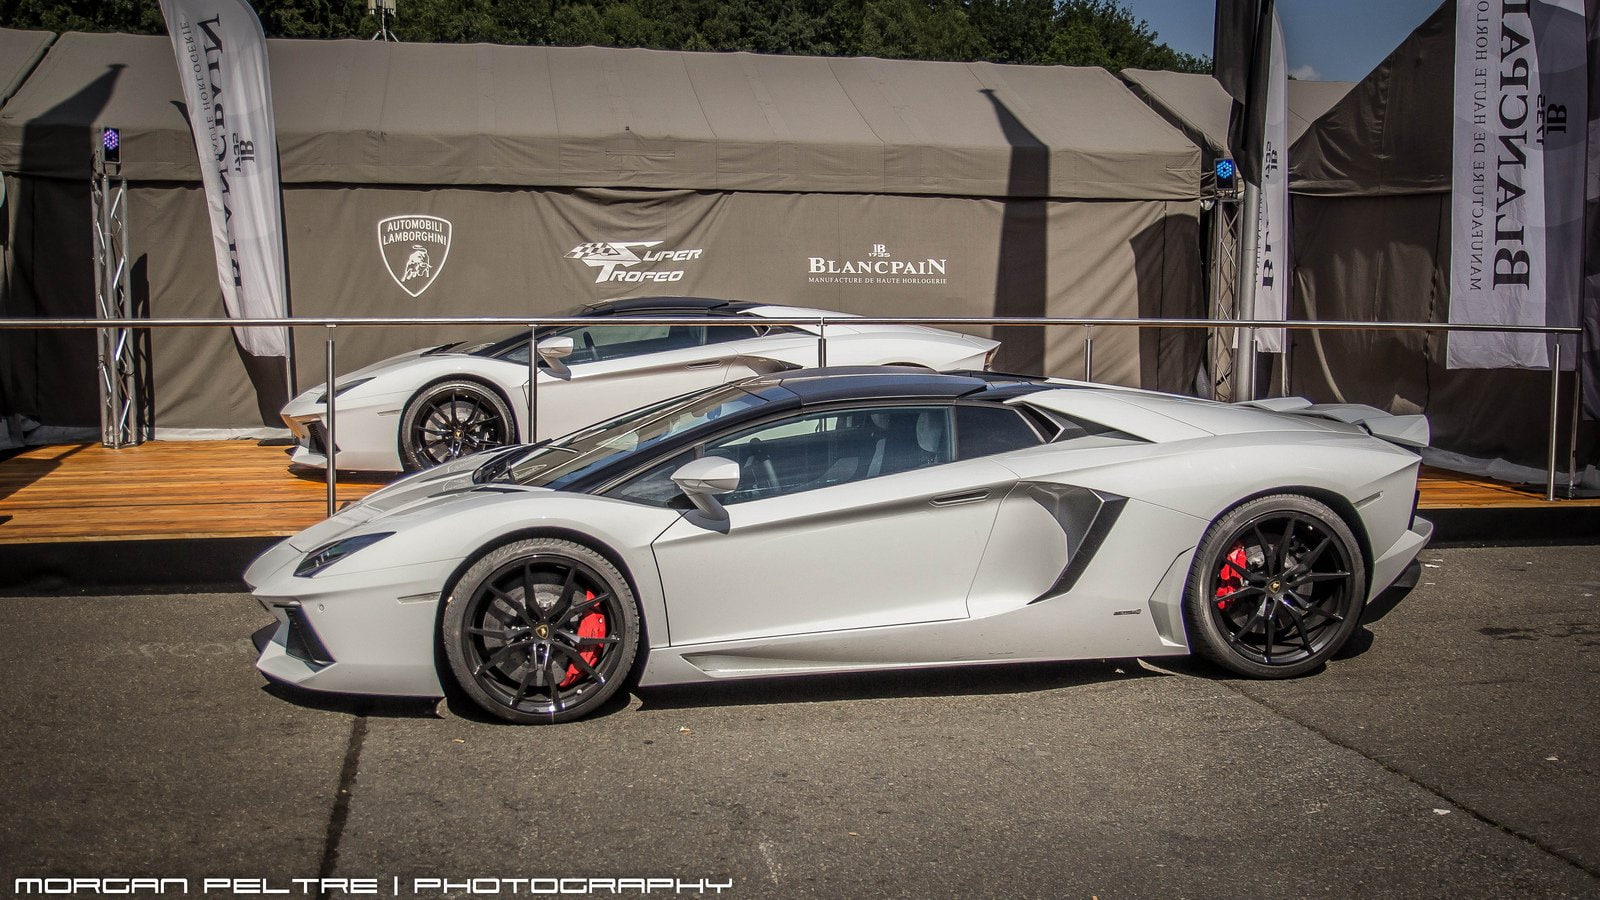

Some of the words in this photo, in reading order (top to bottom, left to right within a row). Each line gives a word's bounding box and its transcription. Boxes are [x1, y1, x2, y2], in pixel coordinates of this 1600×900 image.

[387, 219, 443, 233] AUTOMOBILI
[383, 231, 447, 246] LAMBORGHINI
[807, 257, 947, 275] BLANCPAIN
[808, 276, 863, 284] MANUFACTURE
[876, 277, 901, 285] HAUTE
[902, 277, 947, 285] HORLOGERIE
